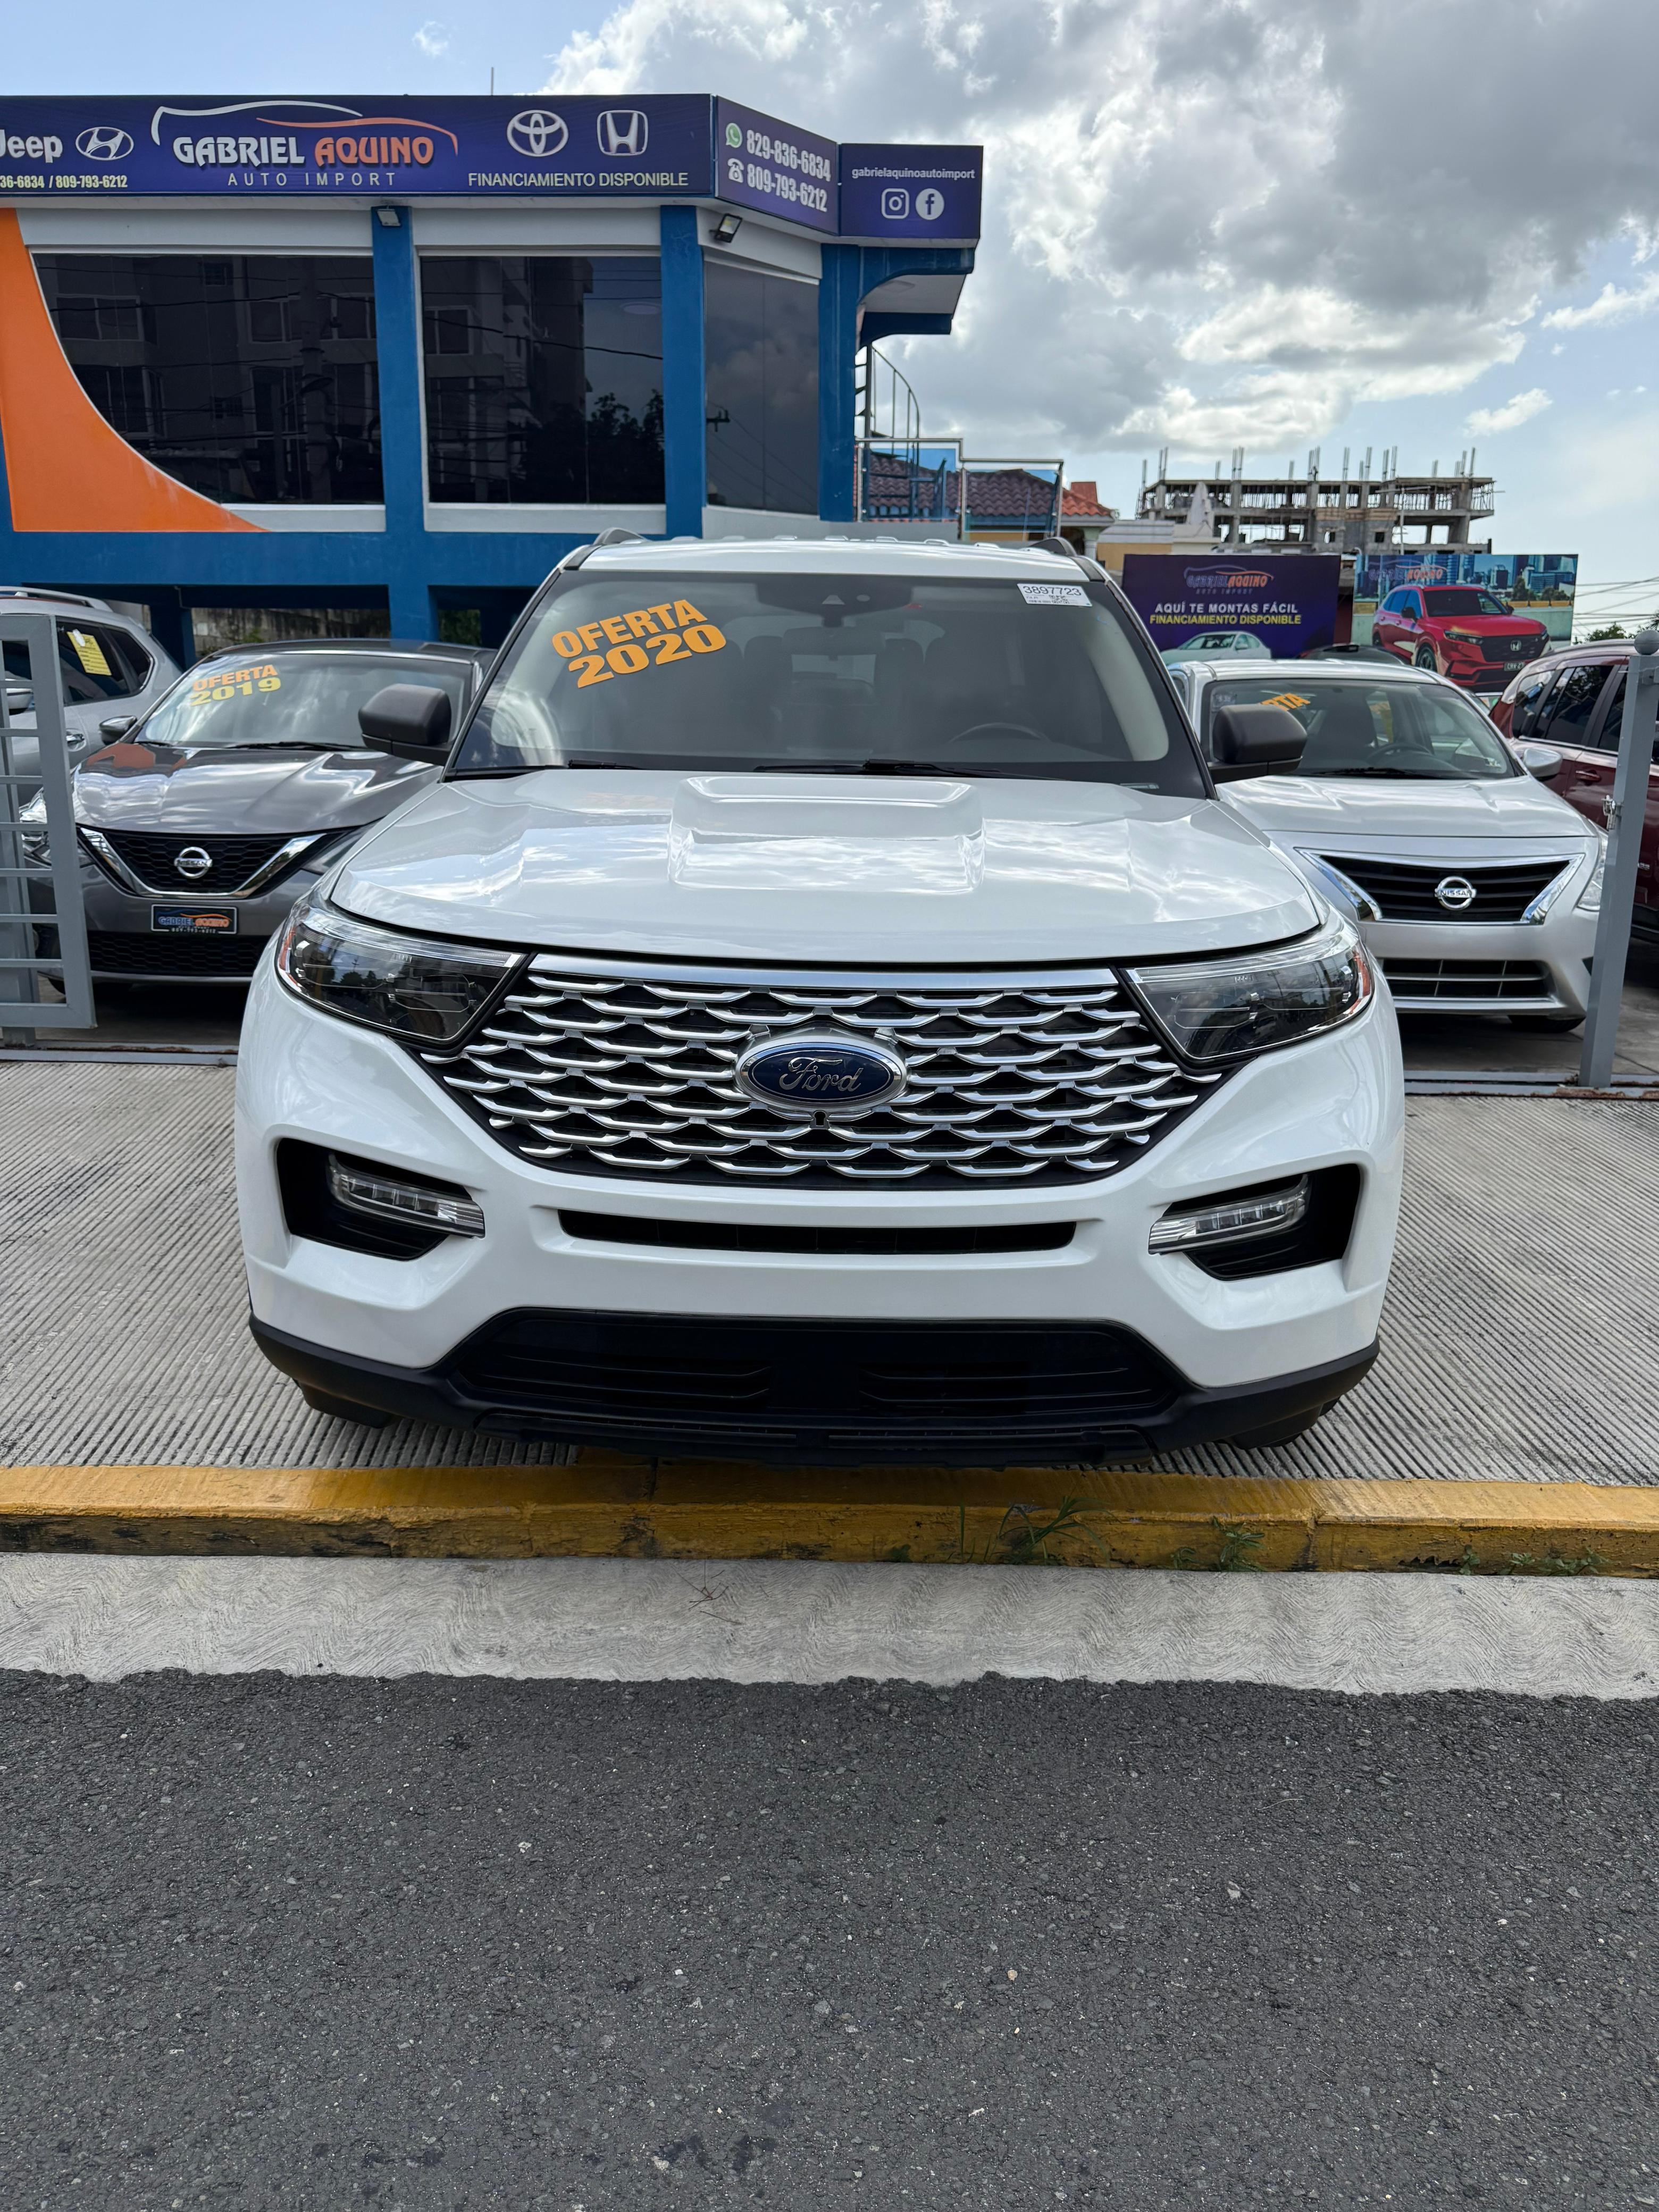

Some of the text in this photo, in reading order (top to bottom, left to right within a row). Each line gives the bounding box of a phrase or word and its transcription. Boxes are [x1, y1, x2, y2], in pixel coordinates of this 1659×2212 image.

[173, 136, 434, 166] GABRIEL AQUINO
[746, 129, 832, 182] 829-836-6834
[55, 175, 128, 188] 809-793-6212
[228, 172, 395, 186] AUTO IMPORT
[468, 172, 689, 187] FINANCIAMIENTO DISPONIBLE
[851, 166, 976, 180] gabrielaquinoautoimport
[747, 163, 828, 212] 809-793-6212
[1023, 586, 1082, 596] 3897723
[1150, 615, 1302, 625] FINANCIAMIENTO DISPONIBLE
[1154, 601, 1298, 613] AQUÍ TE MONTAS FÁCIL
[552, 599, 708, 658] OFERTA
[568, 624, 727, 689] 2020
[192, 664, 279, 691] OFERTA
[190, 677, 281, 707] 2019
[778, 1057, 864, 1092] Ford
